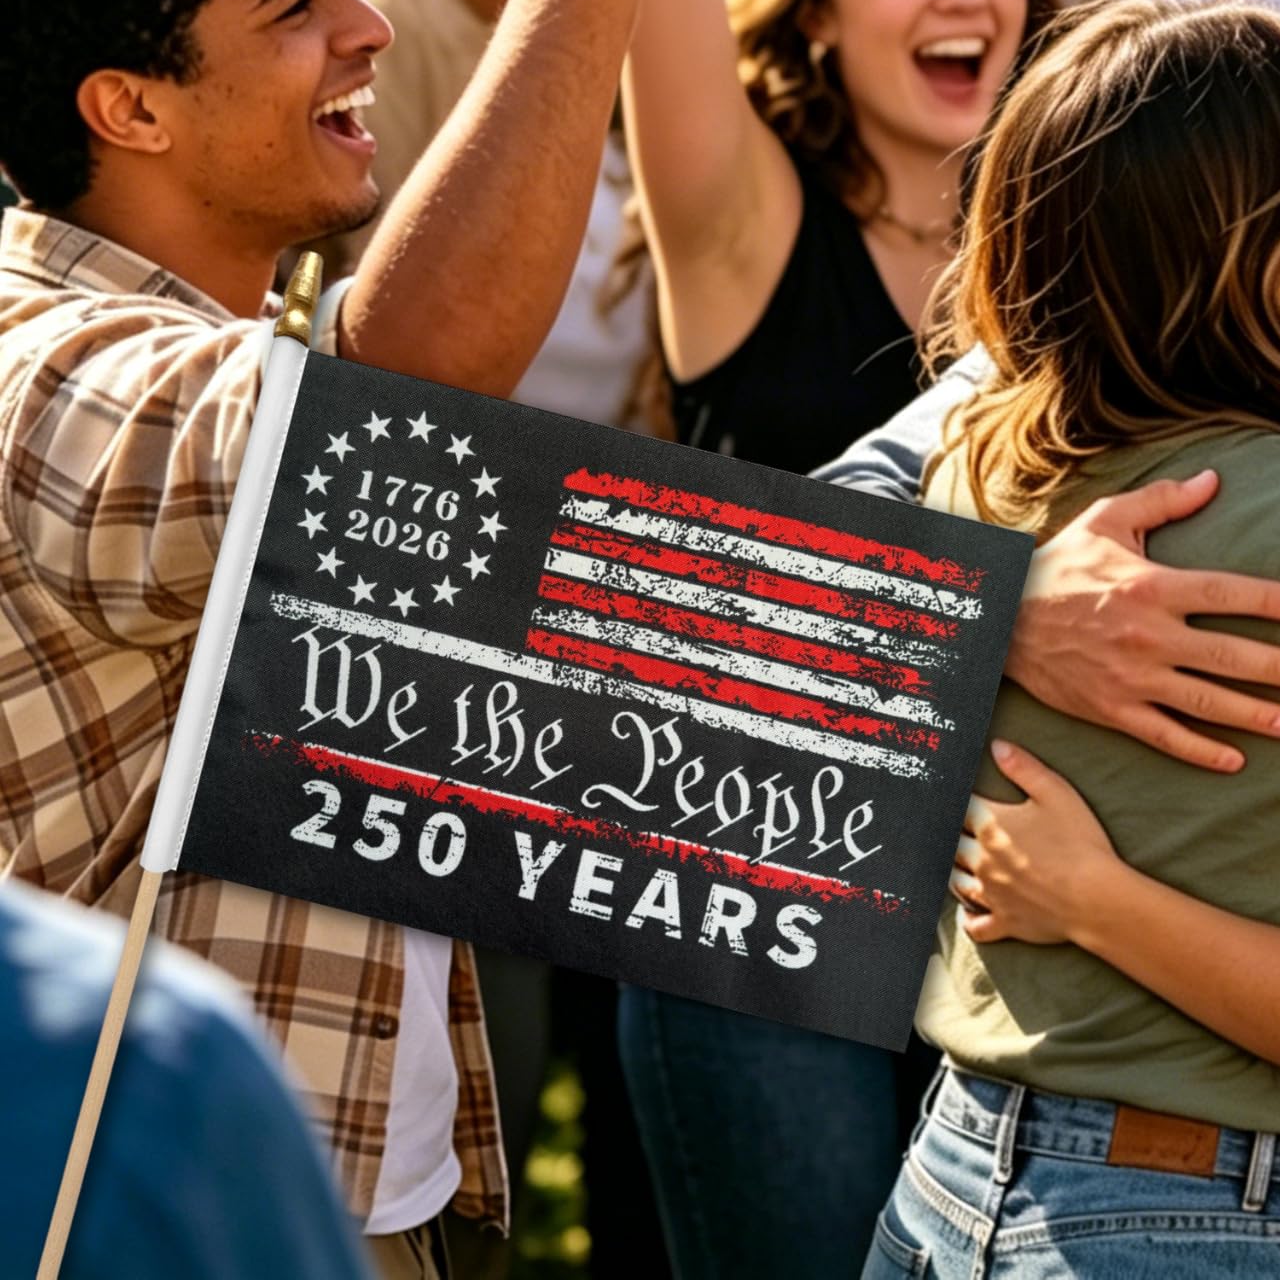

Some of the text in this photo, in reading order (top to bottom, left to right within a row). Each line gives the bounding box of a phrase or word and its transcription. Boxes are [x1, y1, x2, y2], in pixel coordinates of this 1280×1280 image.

[343, 509, 451, 562] 2026
[354, 468, 460, 521] 1776
[291, 624, 883, 870] We the People
[289, 780, 823, 970] 250 YEARS
